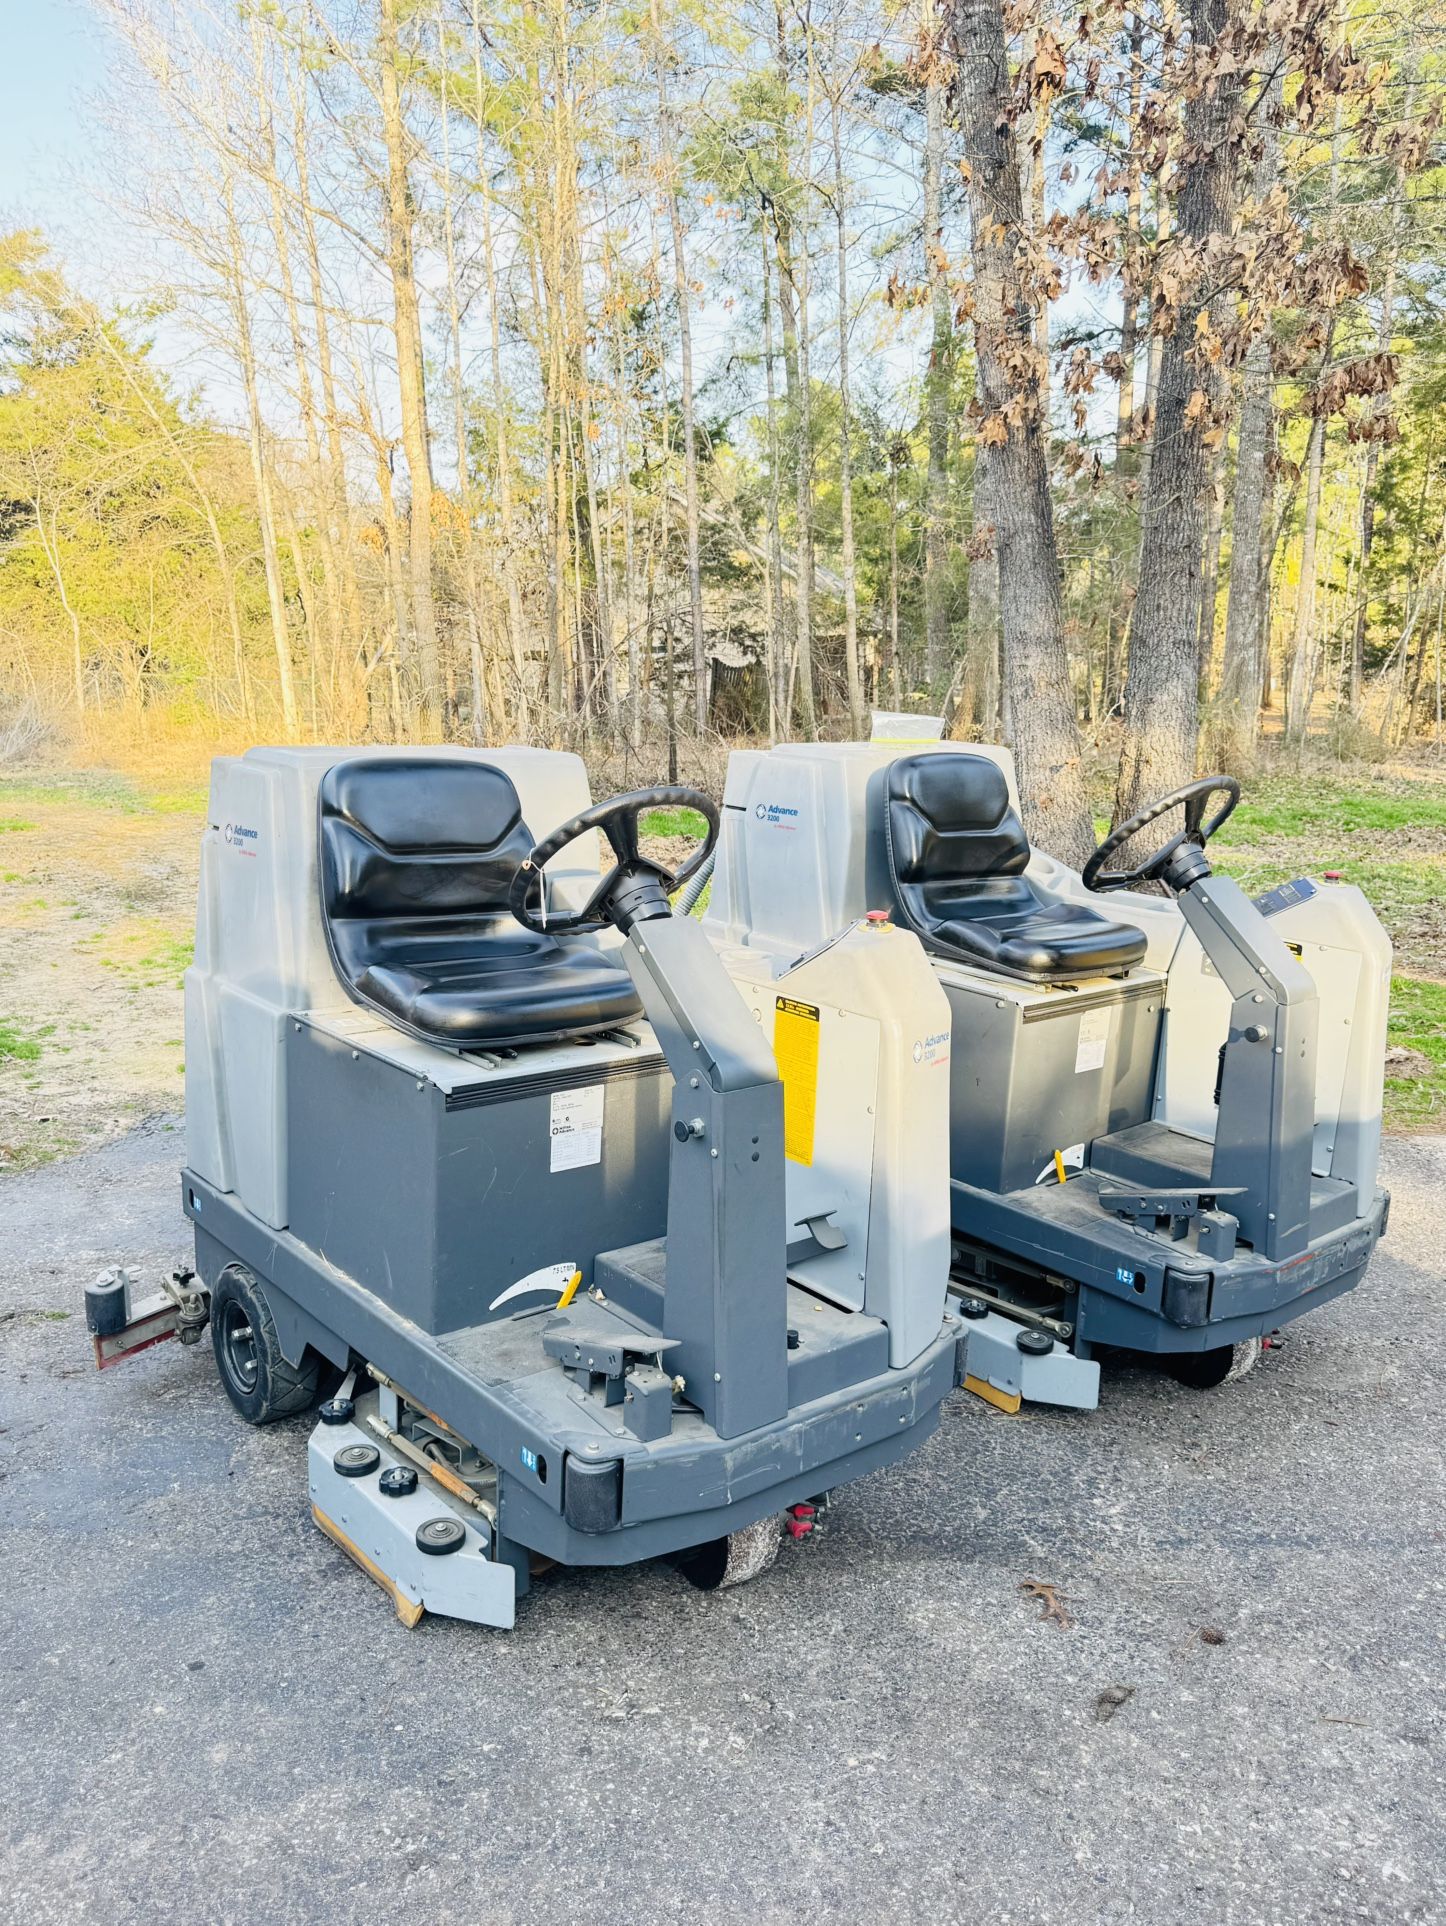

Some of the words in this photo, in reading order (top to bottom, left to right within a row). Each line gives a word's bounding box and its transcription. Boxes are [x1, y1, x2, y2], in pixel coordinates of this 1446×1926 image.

[768, 805, 798, 816] Advance
[767, 814, 780, 822] 3200
[234, 825, 257, 839] Advance
[925, 1032, 949, 1048] Advance
